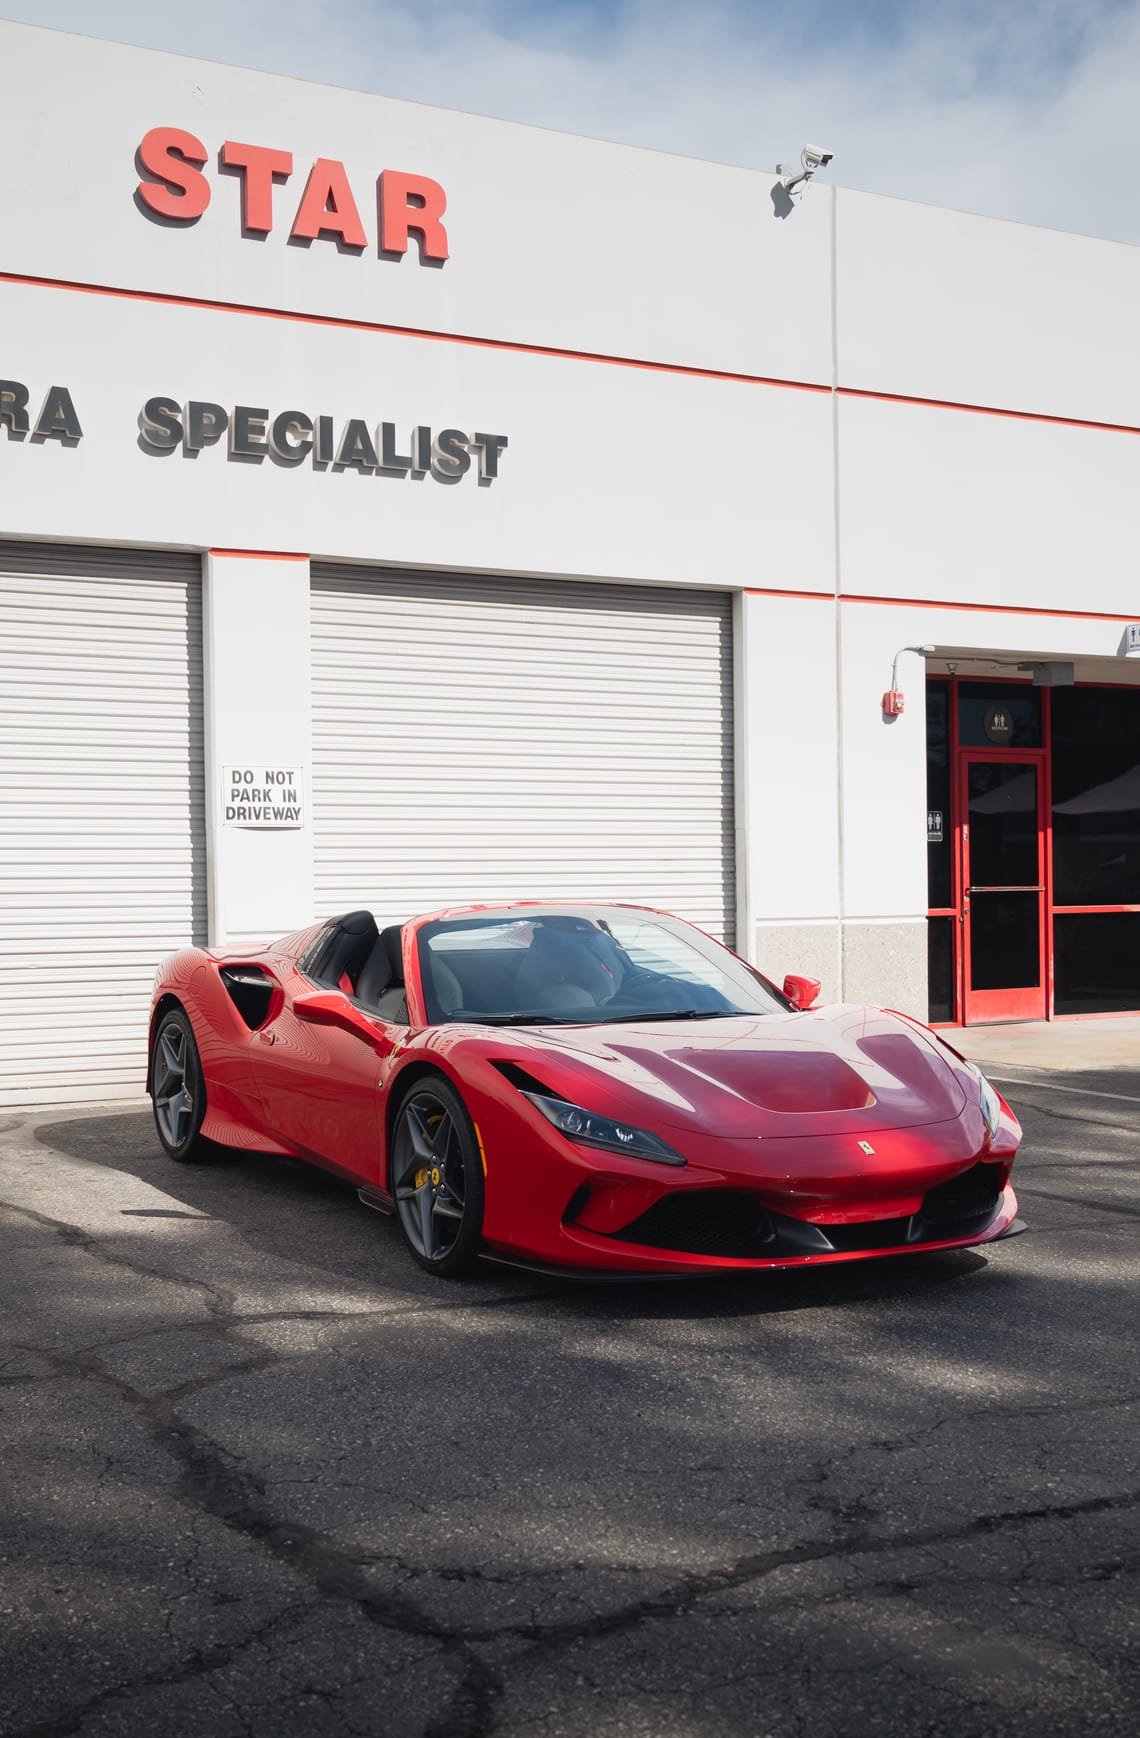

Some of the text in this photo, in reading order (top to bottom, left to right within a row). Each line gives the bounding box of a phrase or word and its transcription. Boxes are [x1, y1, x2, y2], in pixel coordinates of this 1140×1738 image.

[137, 126, 450, 263] STAR
[139, 396, 508, 480] SPECIALIST
[231, 770, 294, 786] DO NOT
[231, 788, 297, 803] PARK IN
[225, 806, 301, 821] DRIVEWAY
